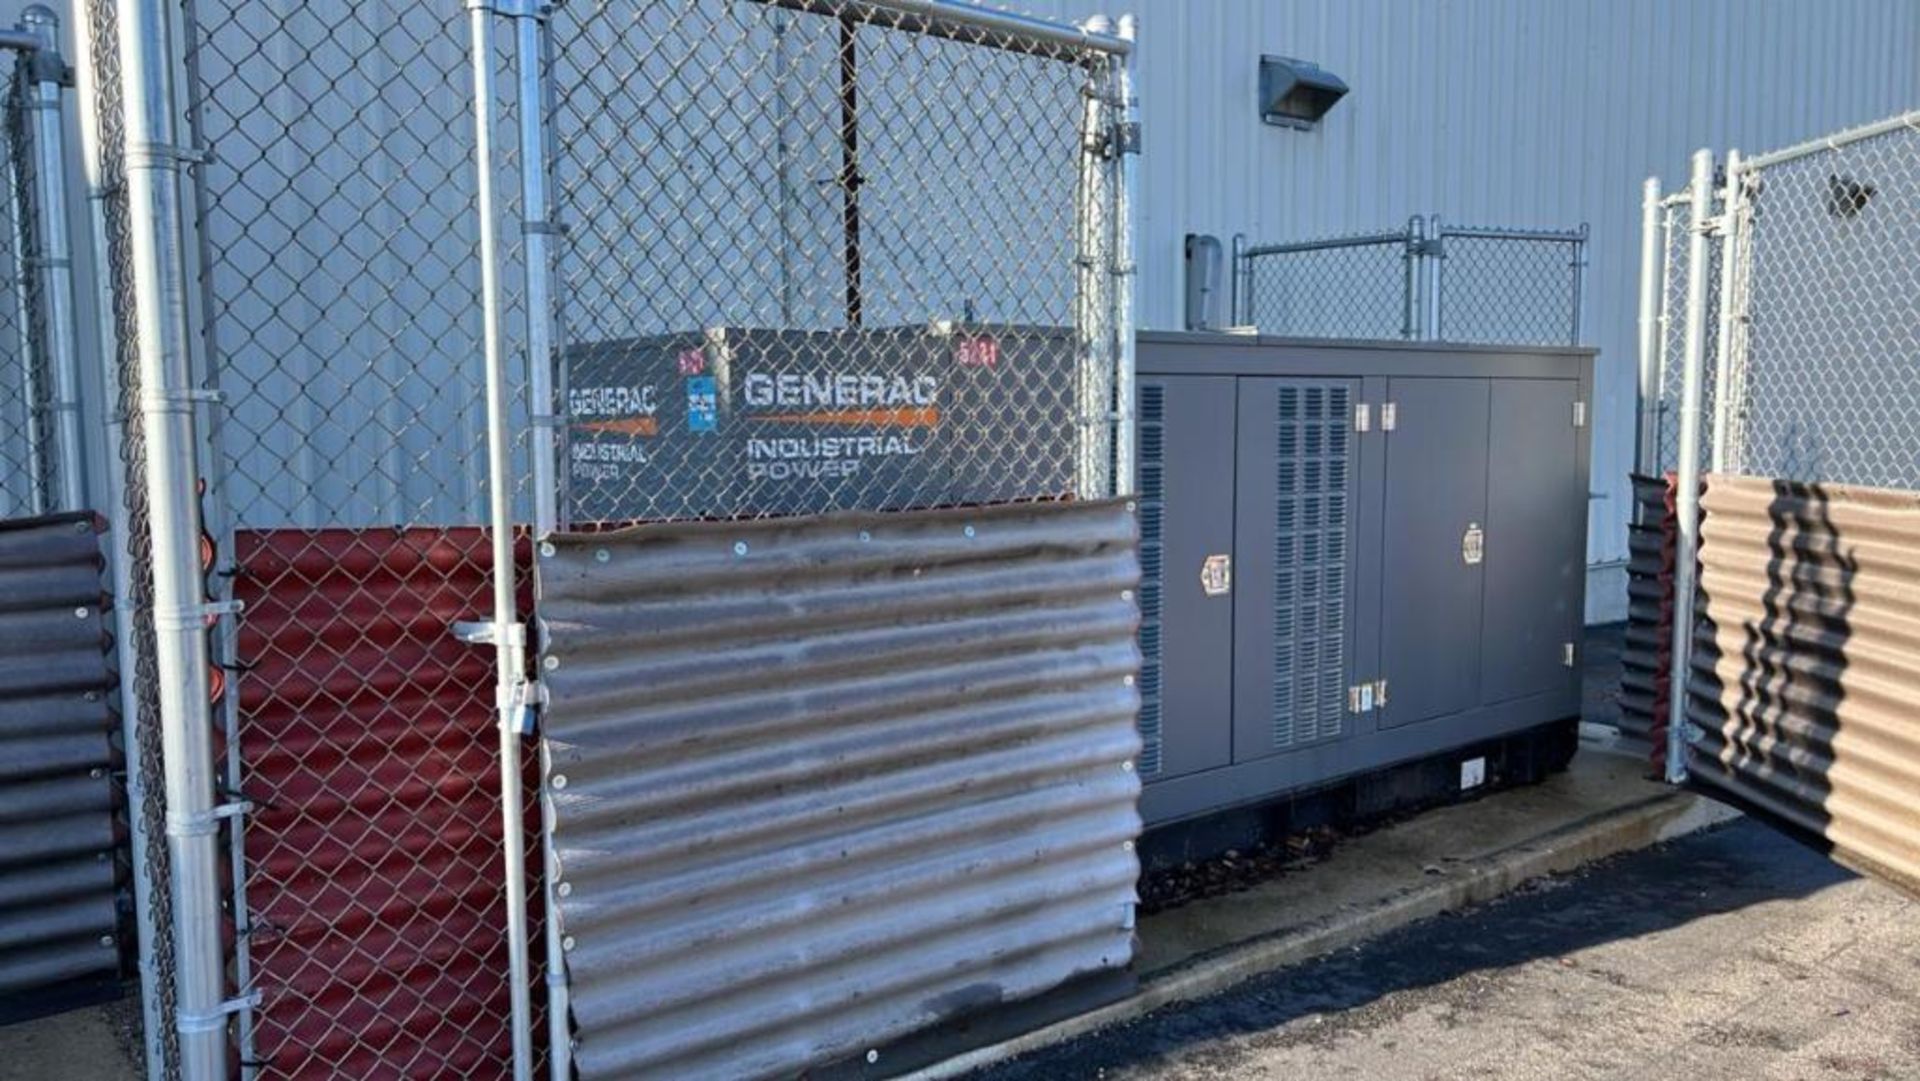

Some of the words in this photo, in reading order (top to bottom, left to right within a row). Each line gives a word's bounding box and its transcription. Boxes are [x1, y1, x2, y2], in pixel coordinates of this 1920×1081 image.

[569, 386, 656, 415] GENERAC
[745, 374, 936, 405] GENERAC
[748, 436, 919, 458] INDUSTRIAL
[749, 460, 860, 480] POWER
